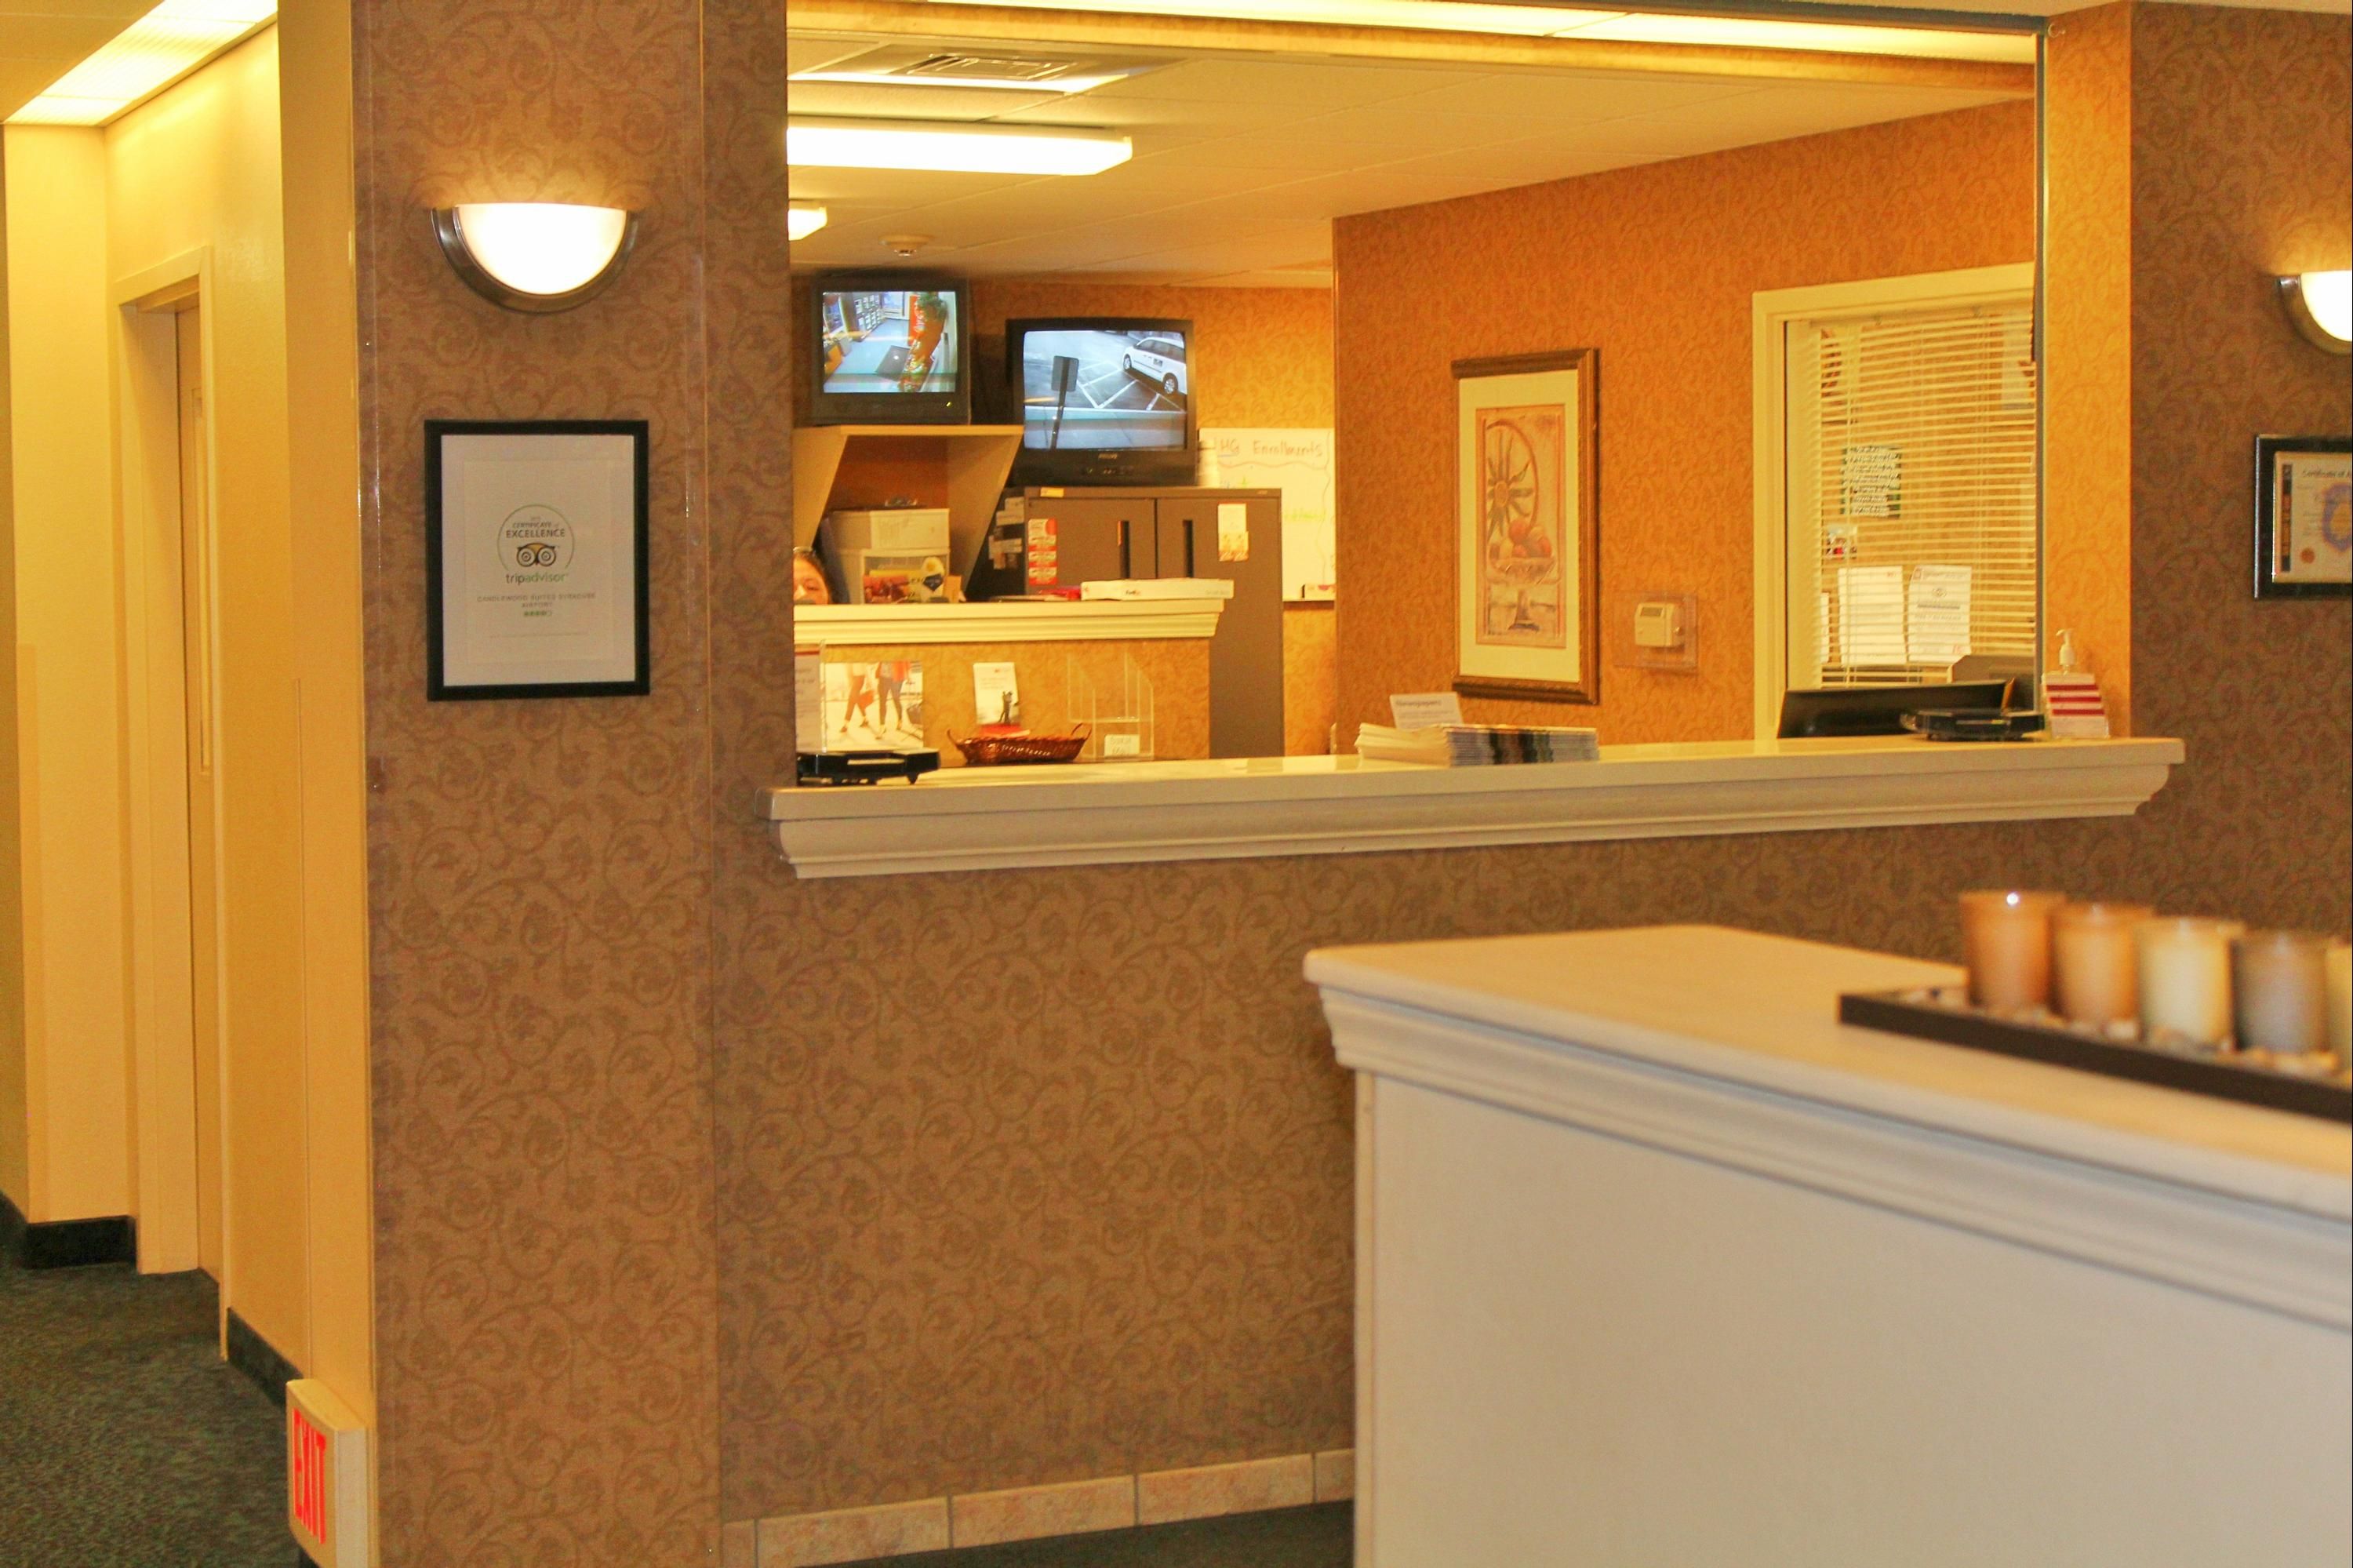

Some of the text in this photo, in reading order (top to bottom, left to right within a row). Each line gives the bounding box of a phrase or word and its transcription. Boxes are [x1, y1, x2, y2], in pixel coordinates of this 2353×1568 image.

[506, 529, 565, 538] EXCELLENCE
[506, 573, 566, 585] tripadvisor
[293, 1408, 326, 1544] EXIT
